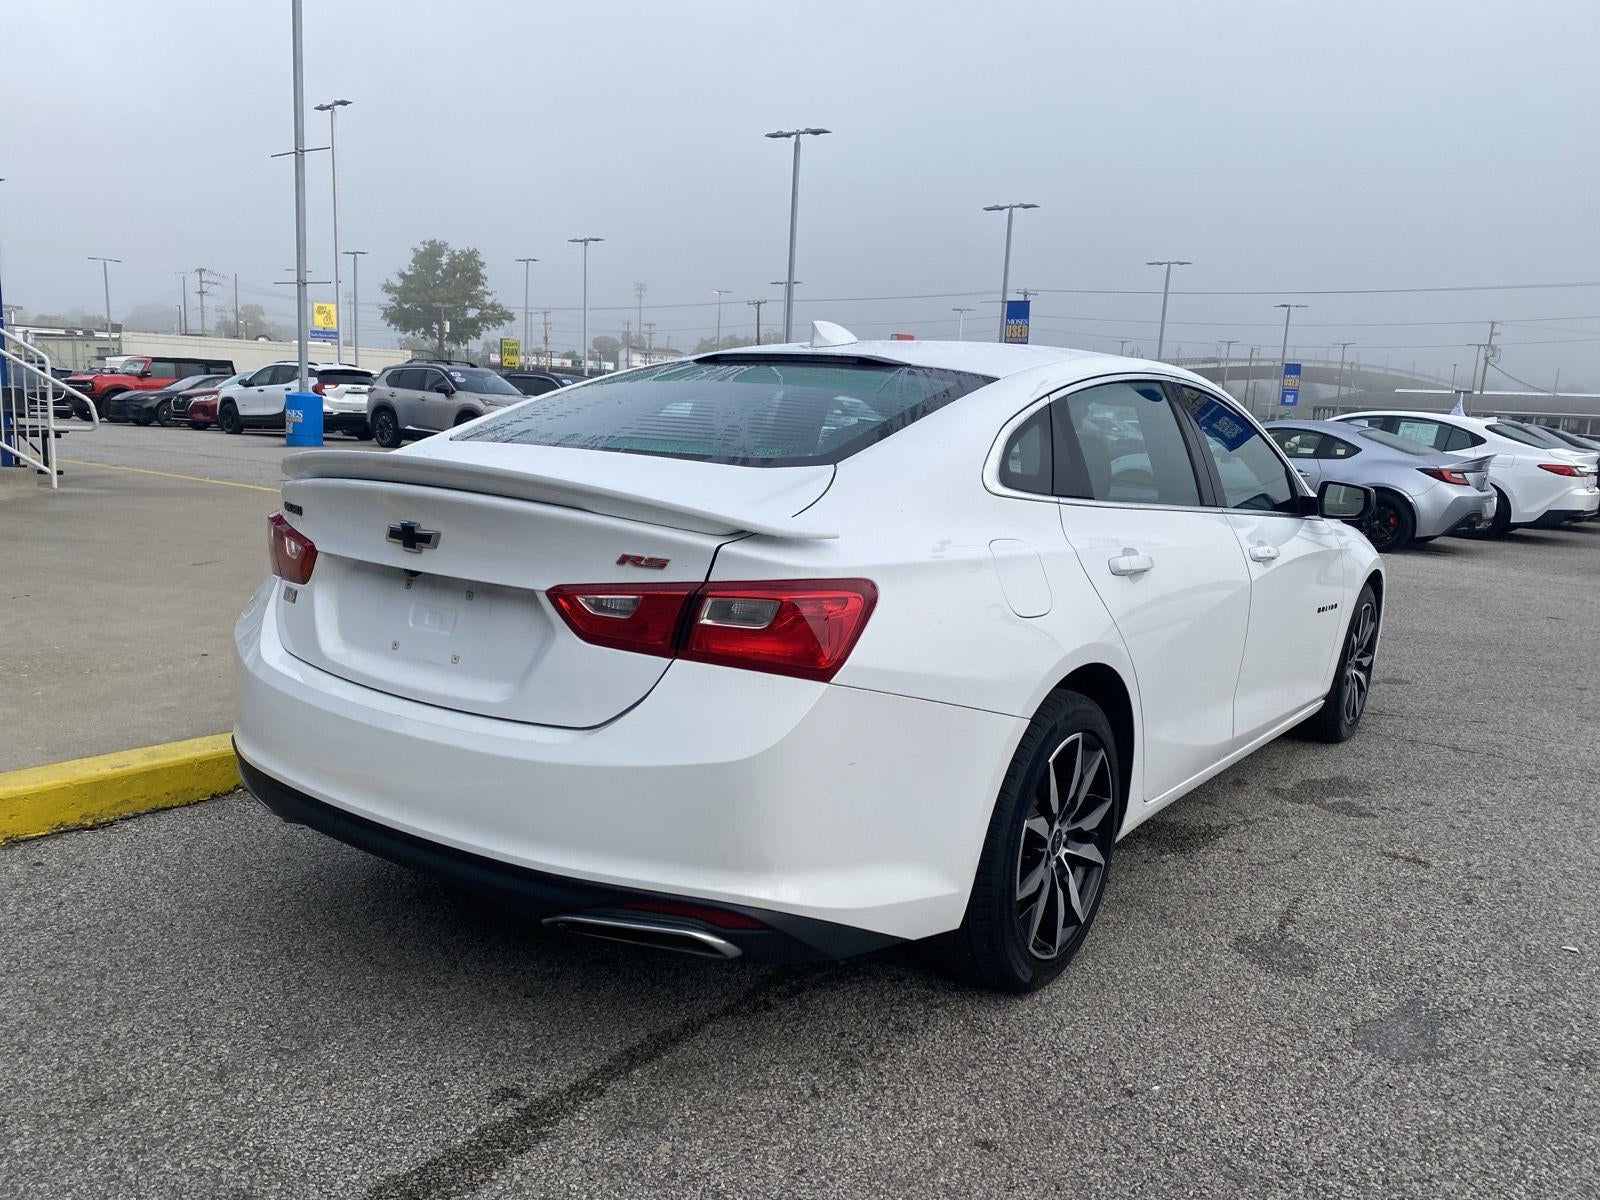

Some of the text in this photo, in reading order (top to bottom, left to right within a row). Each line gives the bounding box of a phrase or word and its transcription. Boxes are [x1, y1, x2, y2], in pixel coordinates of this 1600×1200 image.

[1005, 324, 1029, 338] USED
[1283, 378, 1300, 387] USED
[616, 553, 671, 570] RS
